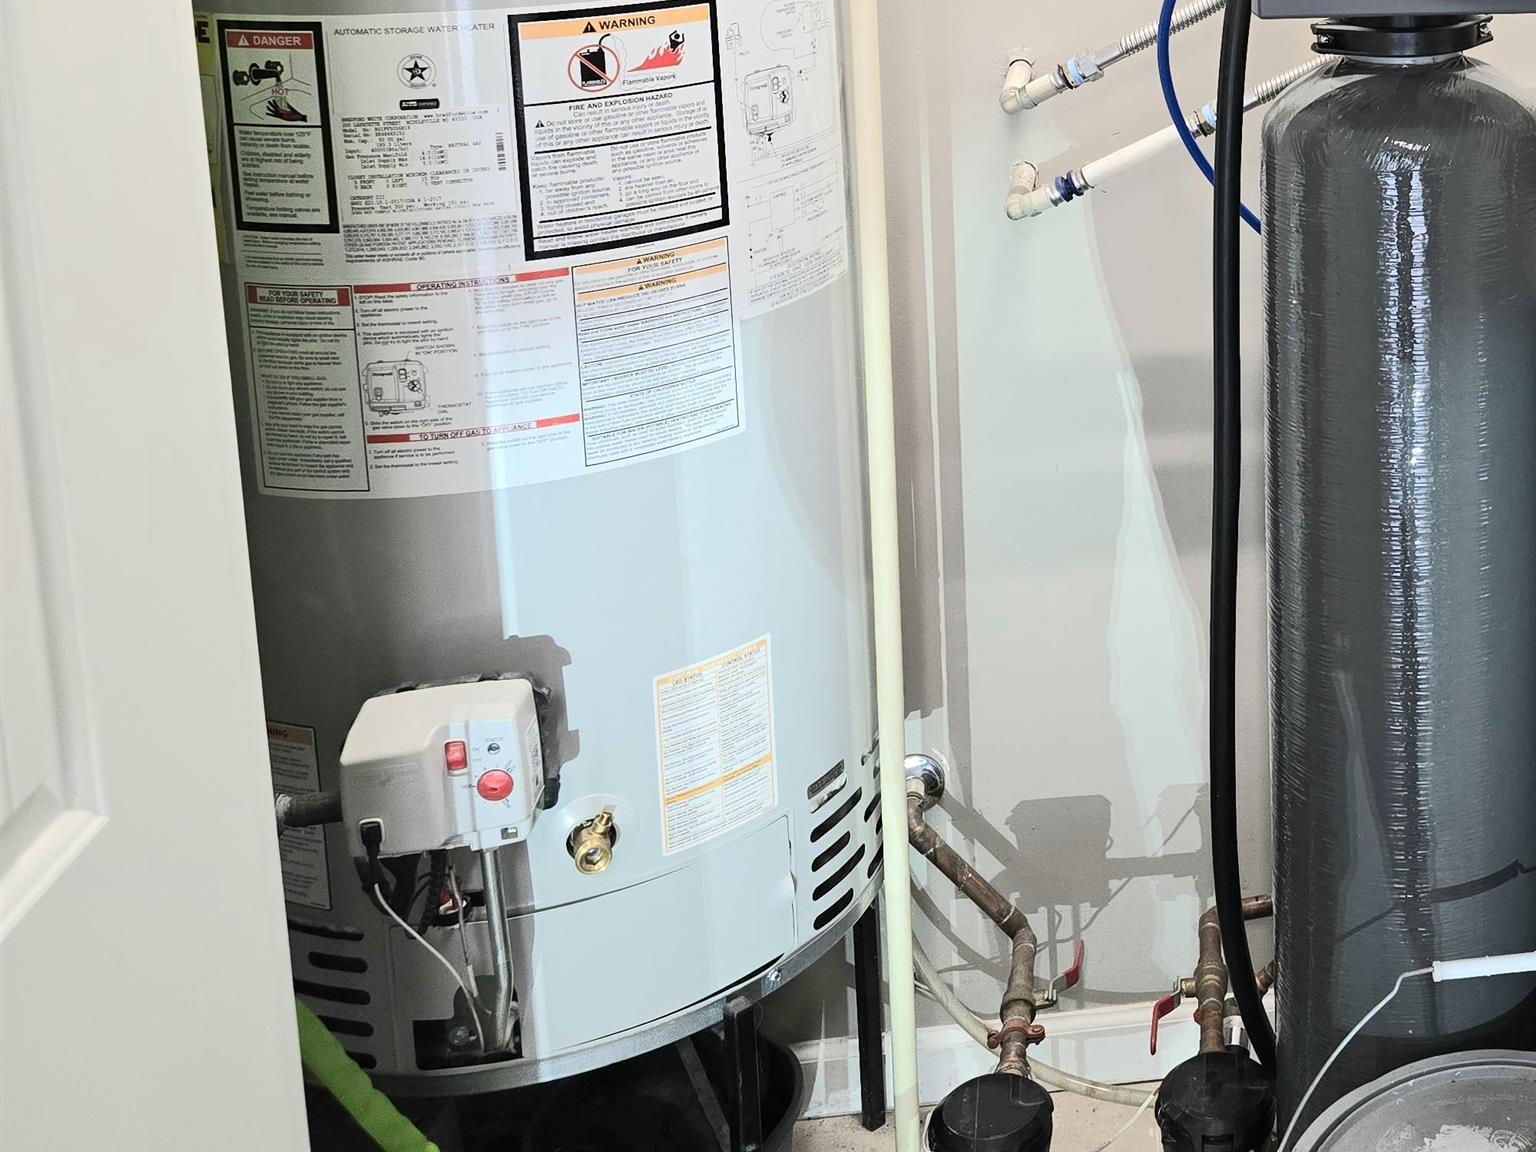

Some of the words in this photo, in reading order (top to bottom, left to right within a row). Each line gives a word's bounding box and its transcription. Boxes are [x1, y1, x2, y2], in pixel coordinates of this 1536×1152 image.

[599, 15, 656, 31] WARNING
[334, 27, 382, 36] AUTOMATIC
[384, 26, 425, 35] STORAGE
[427, 24, 458, 34] WATER
[253, 36, 301, 46] DANGER
[604, 96, 644, 107] EXPLOSION
[643, 252, 675, 263] WARNING
[416, 282, 456, 290] OPERATING
[644, 278, 677, 289] WARNING
[430, 432, 448, 440] TURN
[450, 431, 464, 439] OFF
[465, 429, 481, 437] GAS
